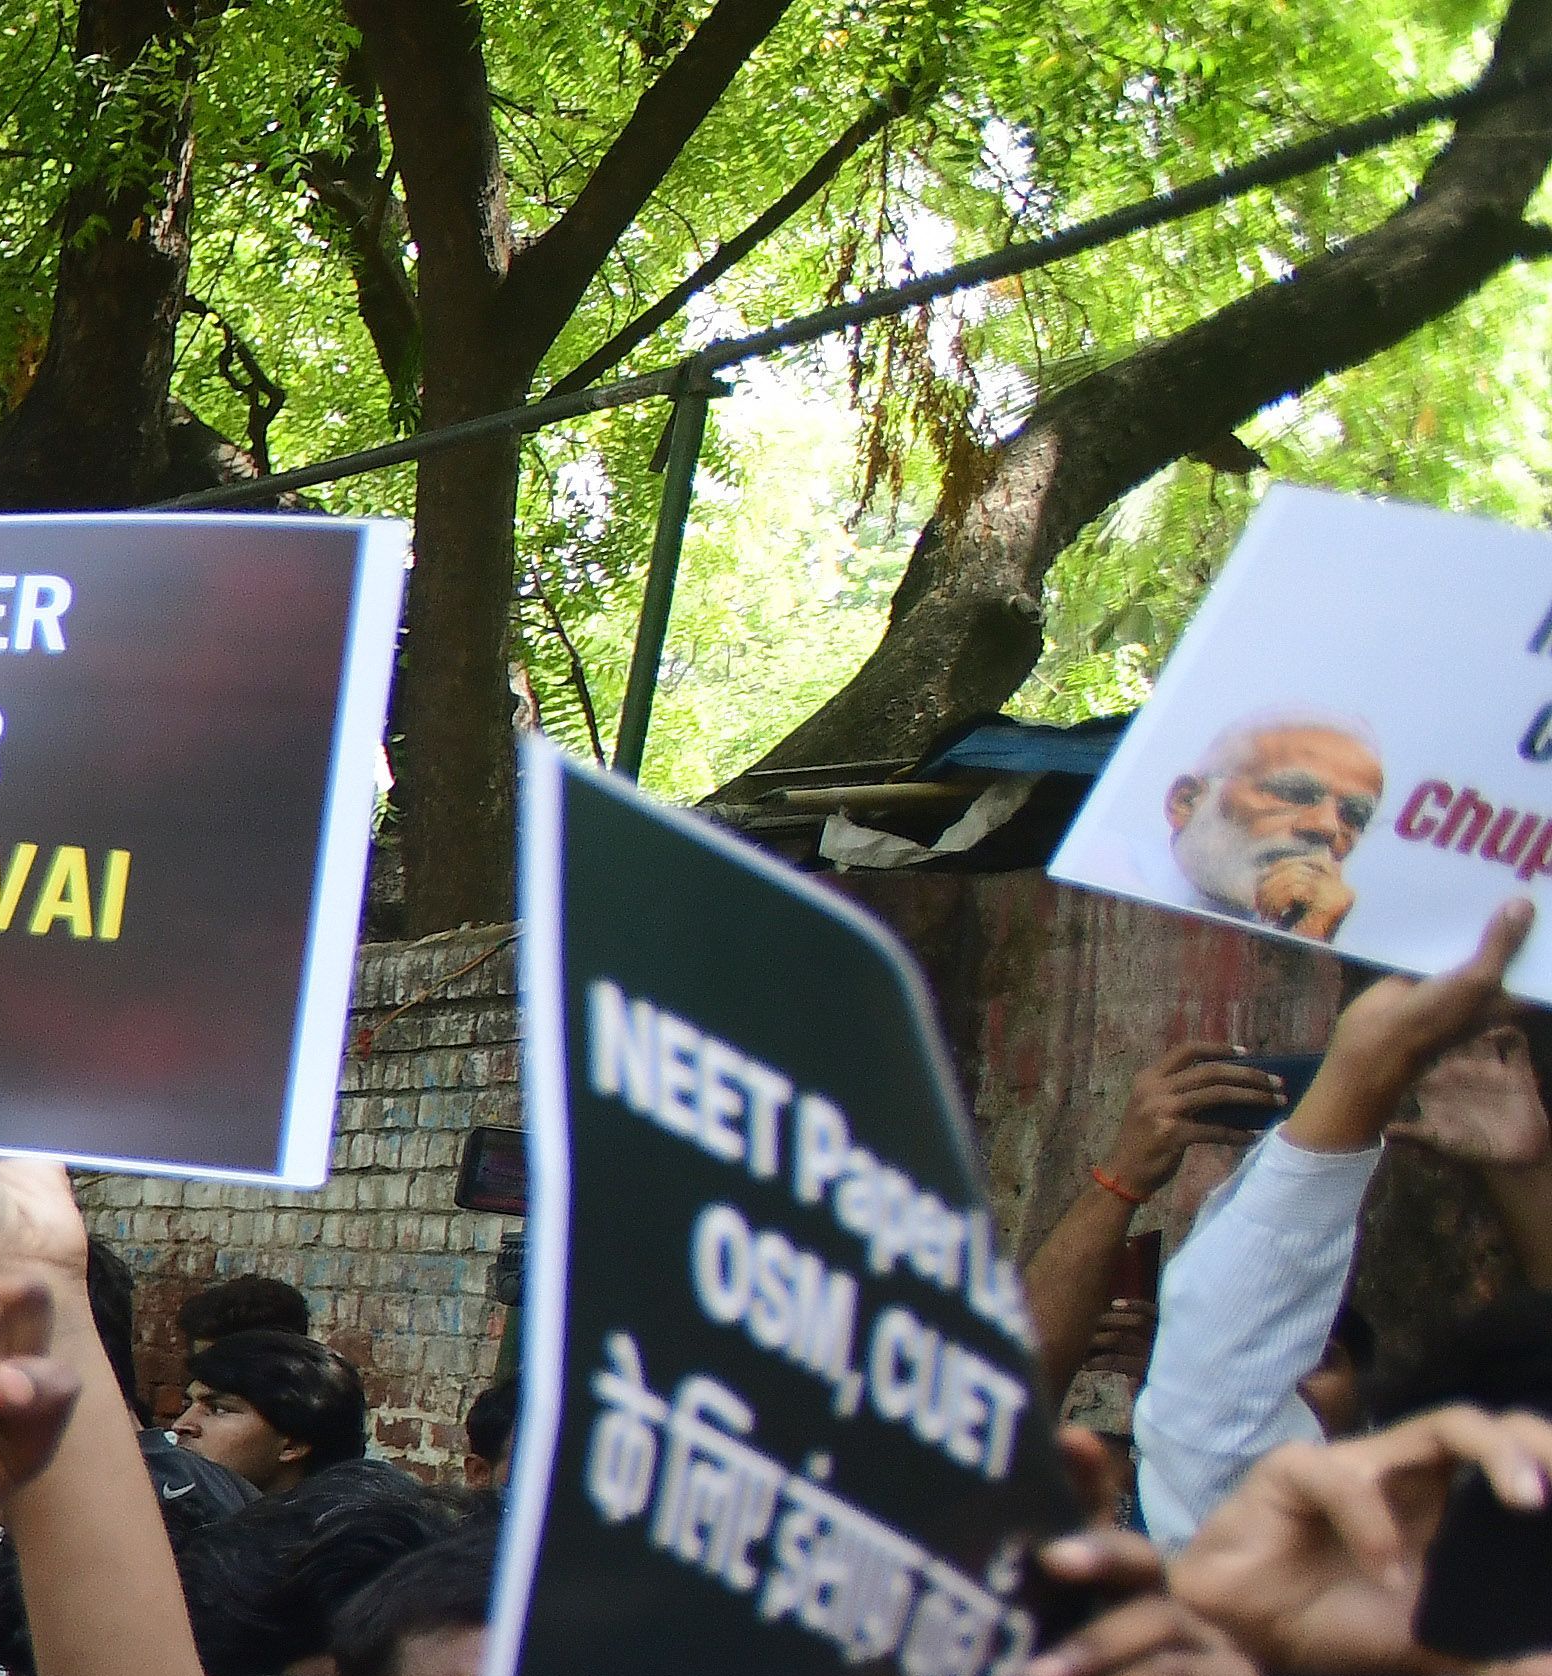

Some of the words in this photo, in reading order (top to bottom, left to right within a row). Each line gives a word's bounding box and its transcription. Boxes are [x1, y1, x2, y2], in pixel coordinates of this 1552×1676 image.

[587, 977, 793, 1180] NEET
[794, 1092, 968, 1288] Paper
[587, 1329, 670, 1523] के
[693, 1202, 862, 1418] OSM,
[869, 1302, 1028, 1481] CUET
